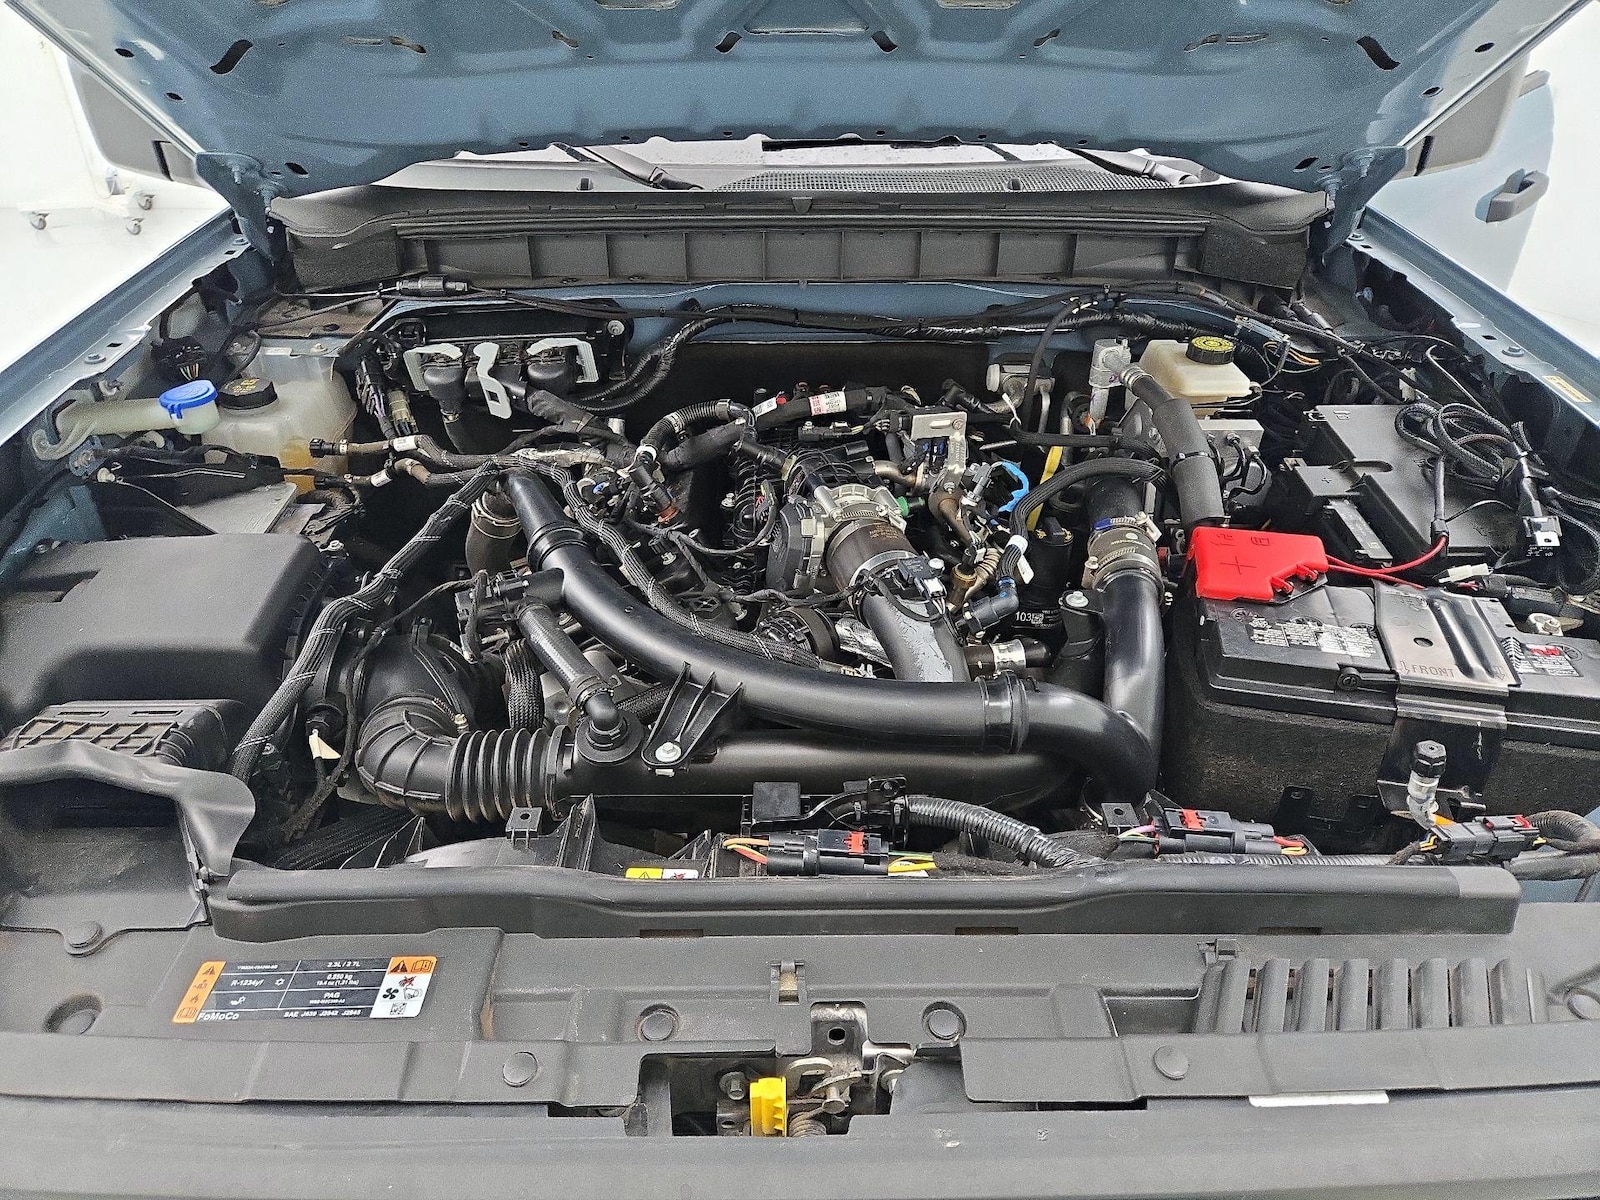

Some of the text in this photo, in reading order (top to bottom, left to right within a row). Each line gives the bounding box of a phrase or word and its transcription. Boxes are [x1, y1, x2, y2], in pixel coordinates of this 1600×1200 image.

[1411, 664, 1456, 678] FRONT
[230, 979, 265, 988] R-1234yf
[197, 1011, 240, 1021] FoMoCo
